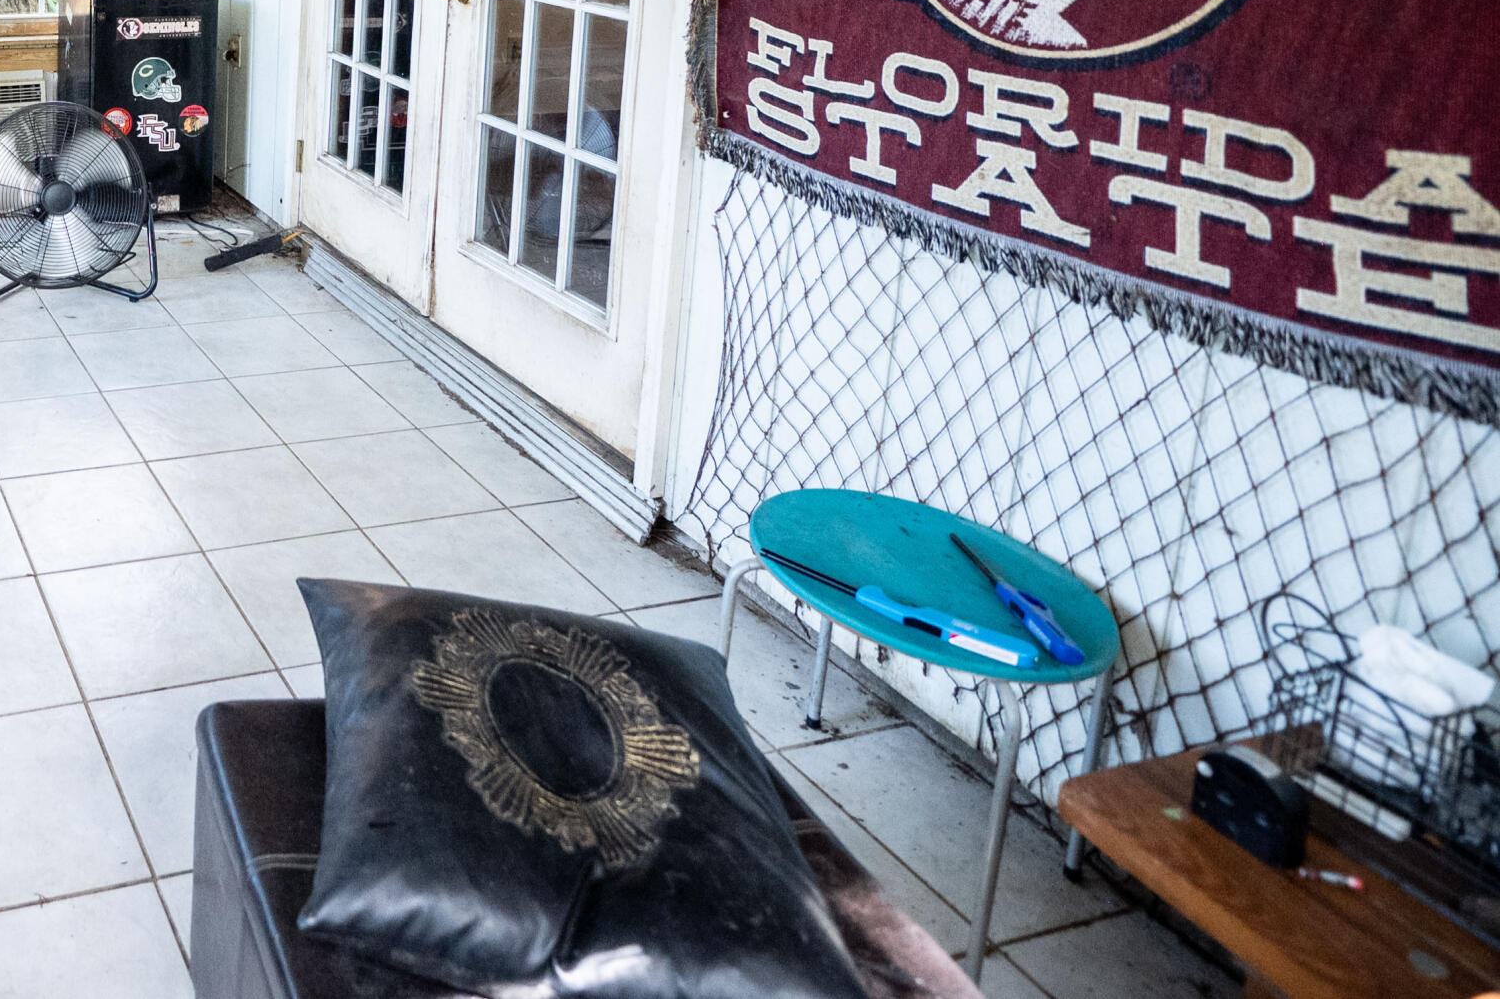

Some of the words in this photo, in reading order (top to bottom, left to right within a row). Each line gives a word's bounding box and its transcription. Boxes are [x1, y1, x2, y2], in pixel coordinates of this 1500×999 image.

[138, 113, 180, 152] FSU
[747, 17, 1500, 237] FLORIDA
[747, 77, 1500, 352] STATE
